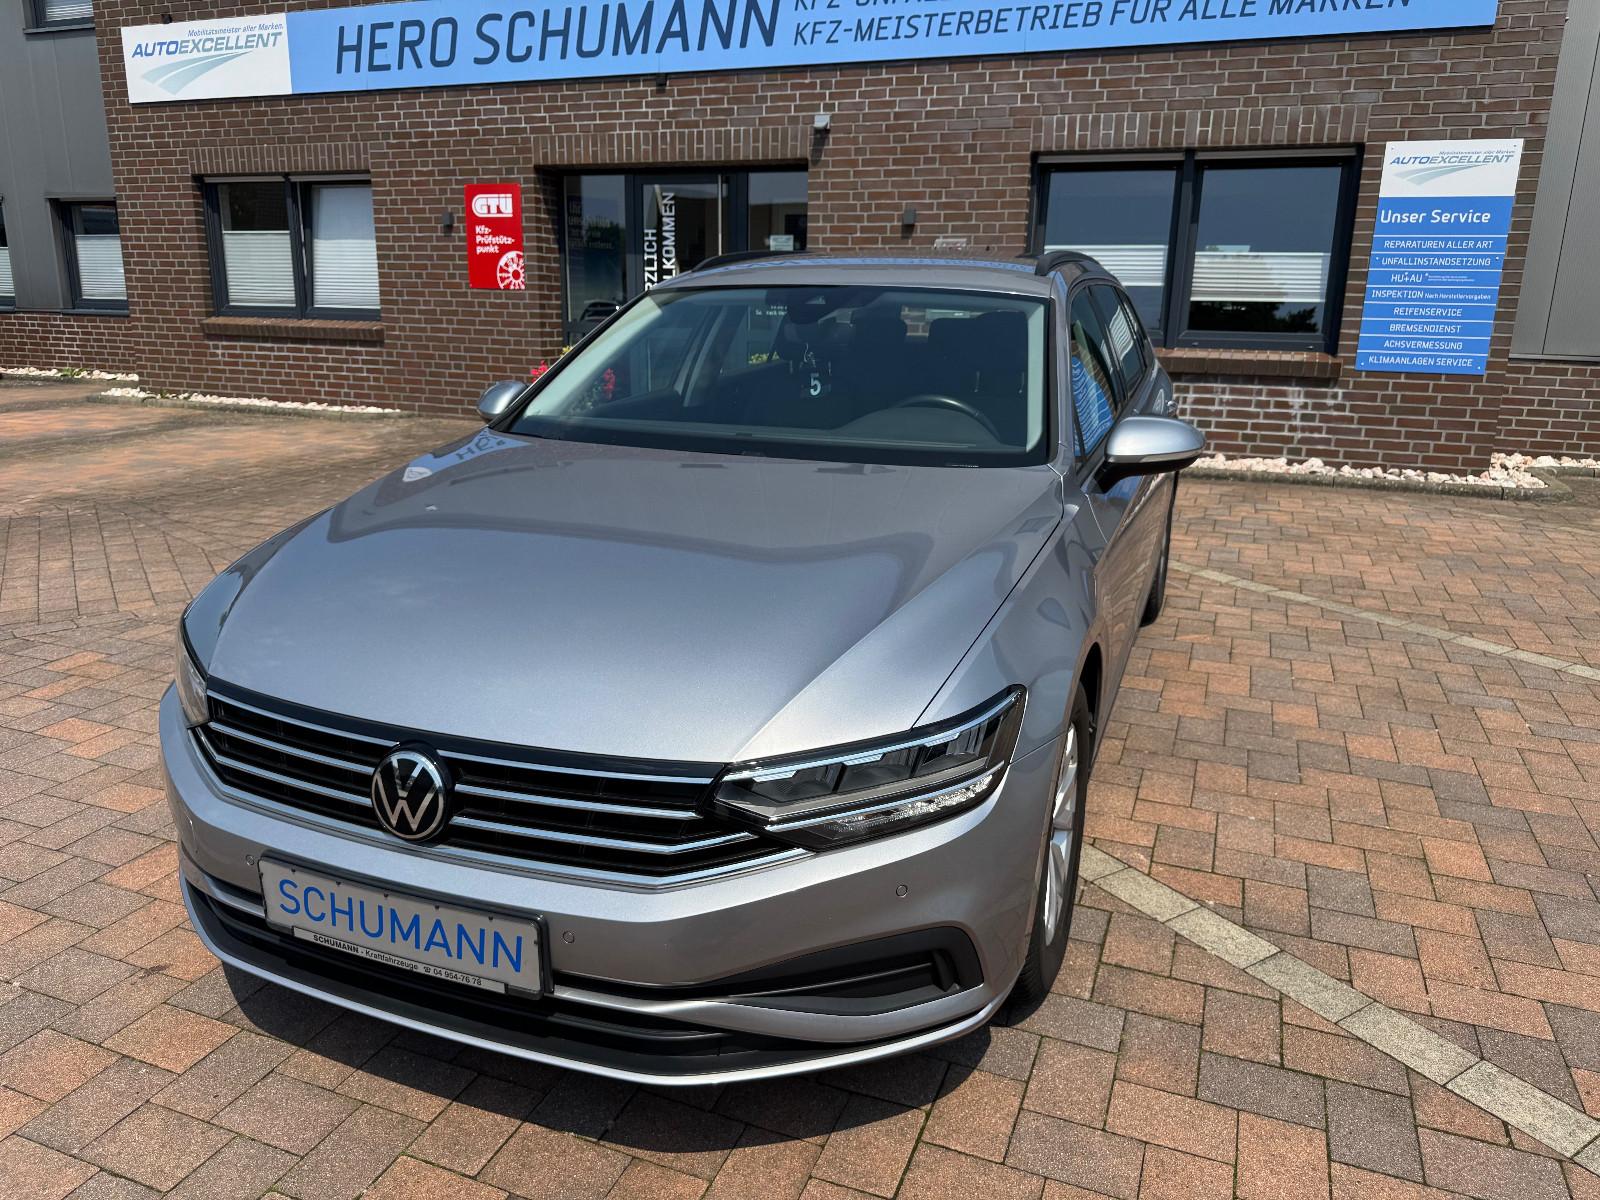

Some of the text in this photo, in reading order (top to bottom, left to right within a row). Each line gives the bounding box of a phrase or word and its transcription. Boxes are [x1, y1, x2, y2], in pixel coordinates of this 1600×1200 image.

[793, 1, 1103, 46] KFZ-MEISTERBETRIEB
[1177, 0, 1257, 21] ALLE
[336, 0, 781, 74] HERO SCHUMANN
[131, 31, 283, 58] AUTOEXCELLENT
[1390, 154, 1514, 165] AUTOEXCELLENT
[472, 194, 513, 217] GTÜ
[1380, 209, 1491, 224] Unser Service
[475, 225, 491, 234] Kfz-
[475, 235, 515, 245] Prüfstütz-
[662, 192, 676, 281] LKOMMEN
[476, 245, 499, 255] punkt
[1384, 240, 1494, 249] REPARATUREN ALLER ART
[644, 229, 657, 291] RZLICH
[1381, 257, 1491, 266] UNFALLINSTANDSETZUNG
[1371, 289, 1424, 299] INSPEKTION
[1393, 307, 1463, 317] REIFENSERVICE
[1389, 323, 1462, 334] BREMSENDIENST
[1383, 340, 1463, 351] ACHSVERMESSUNG
[1368, 355, 1473, 367] KLIMAANLAGEN SERVICE
[810, 373, 821, 396] 5
[278, 878, 523, 973] SCHUMANN
[313, 934, 360, 953] SCHUMANN
